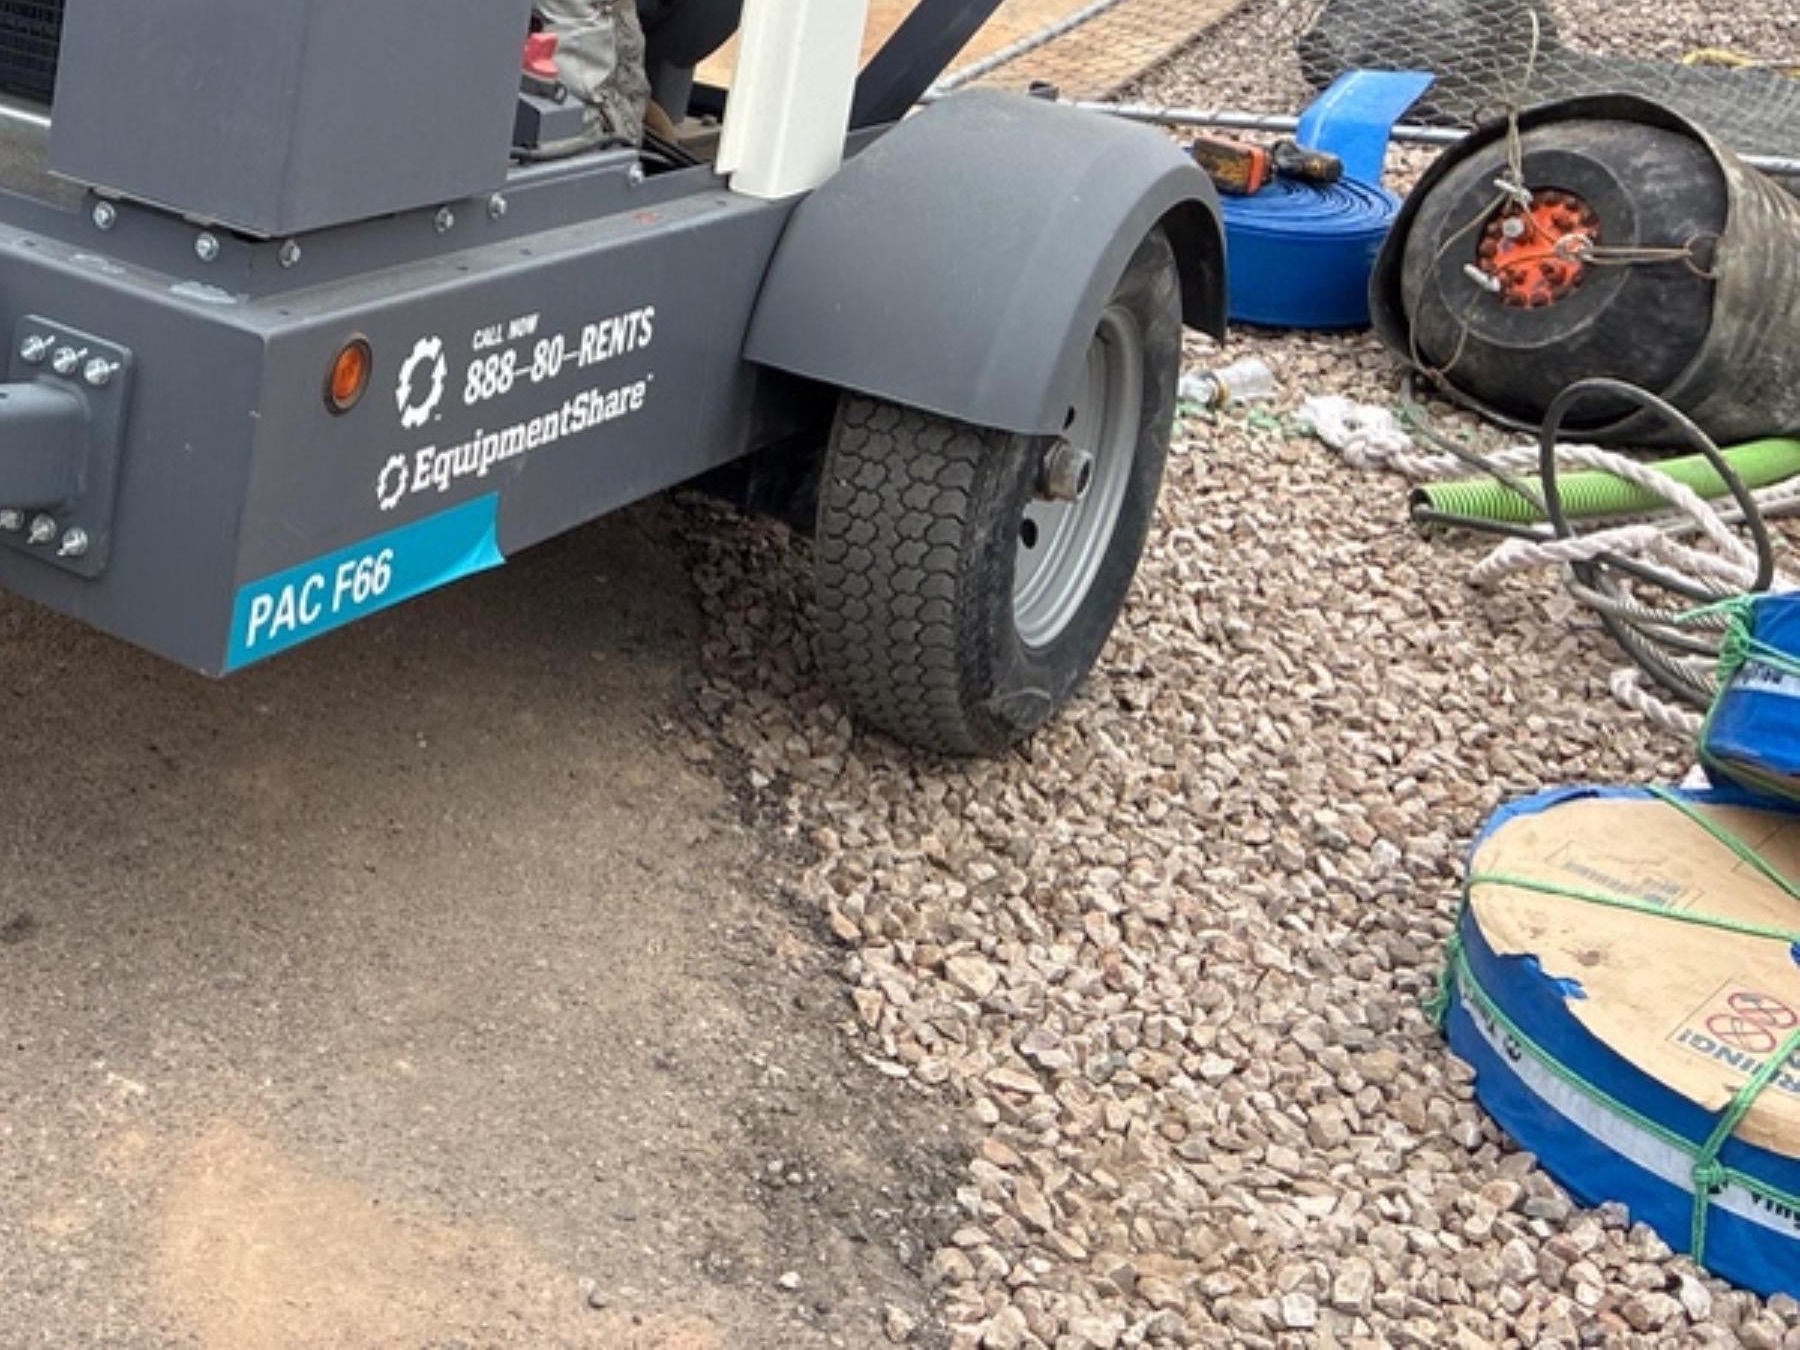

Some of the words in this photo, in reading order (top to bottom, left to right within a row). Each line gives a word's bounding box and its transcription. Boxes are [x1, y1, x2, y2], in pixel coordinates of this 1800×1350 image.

[464, 305, 655, 405] 888-80-RENTS
[473, 323, 503, 351] CALL
[507, 312, 540, 340] NOW
[410, 381, 647, 492] EquipmentShare
[246, 572, 325, 648] PAC
[332, 548, 394, 613] F66
